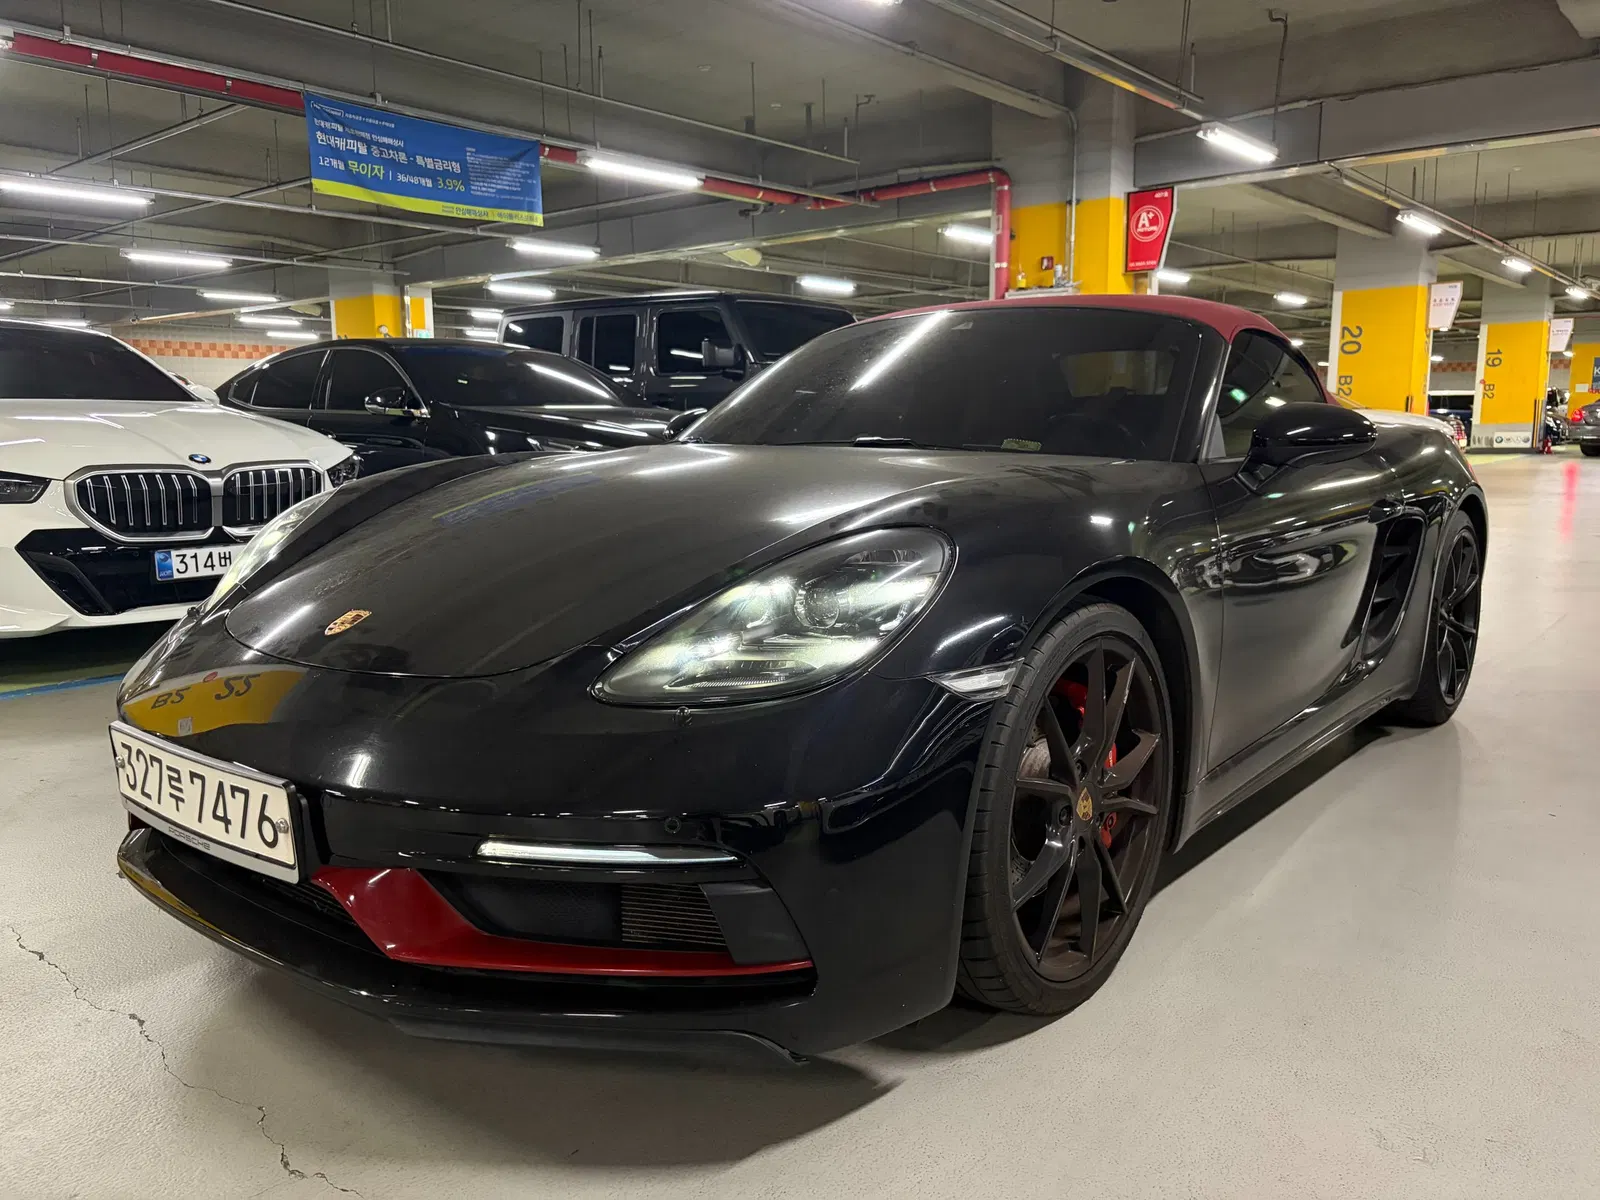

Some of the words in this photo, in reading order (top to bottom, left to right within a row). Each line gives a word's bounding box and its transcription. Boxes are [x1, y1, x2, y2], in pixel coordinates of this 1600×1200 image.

[315, 130, 368, 155] 현대캐피탈
[370, 145, 408, 164] 중고차론
[415, 155, 461, 173] 특별금리형
[318, 156, 345, 171] 12개월
[347, 160, 385, 180] 무이자
[396, 172, 433, 188] 36/48개월
[436, 177, 466, 192] 3.9%
[1341, 325, 1363, 355] 20
[1486, 349, 1502, 368] 19
[1337, 375, 1353, 397] B2
[1483, 383, 1495, 399] B2
